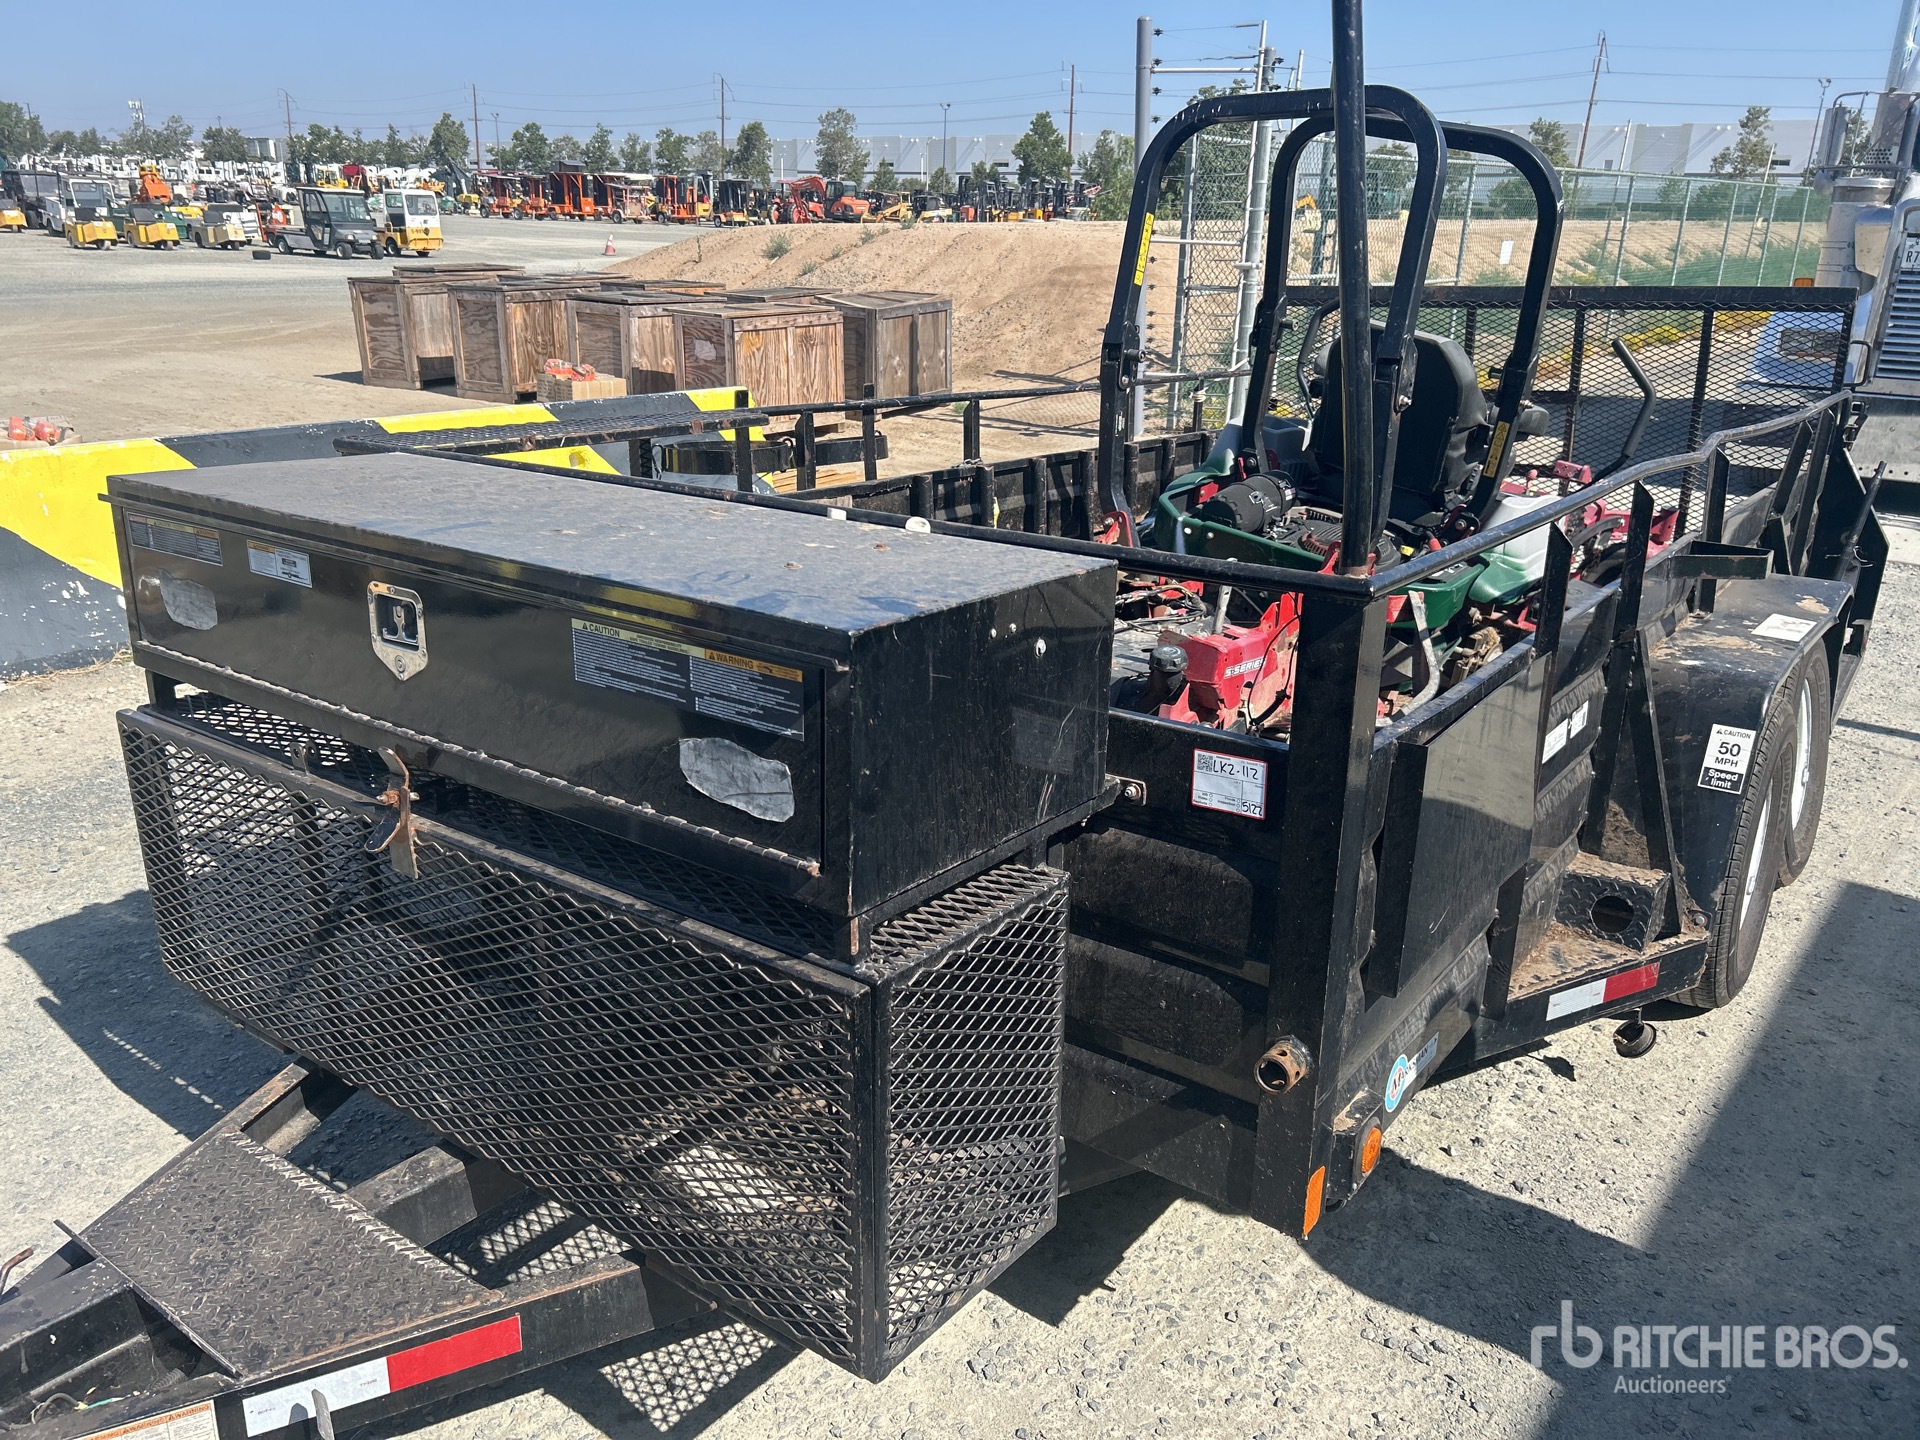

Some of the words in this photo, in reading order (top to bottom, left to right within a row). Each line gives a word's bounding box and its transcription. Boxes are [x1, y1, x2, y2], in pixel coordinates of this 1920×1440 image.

[589, 624, 620, 638] CAUTION
[716, 652, 754, 670] WARNING
[1723, 729, 1752, 739] CAUTION
[1717, 741, 1742, 757] 50
[1714, 756, 1739, 768] MPH
[1708, 768, 1739, 782] Speed
[1710, 777, 1732, 789] limit
[174, 1404, 210, 1419] WARNING
